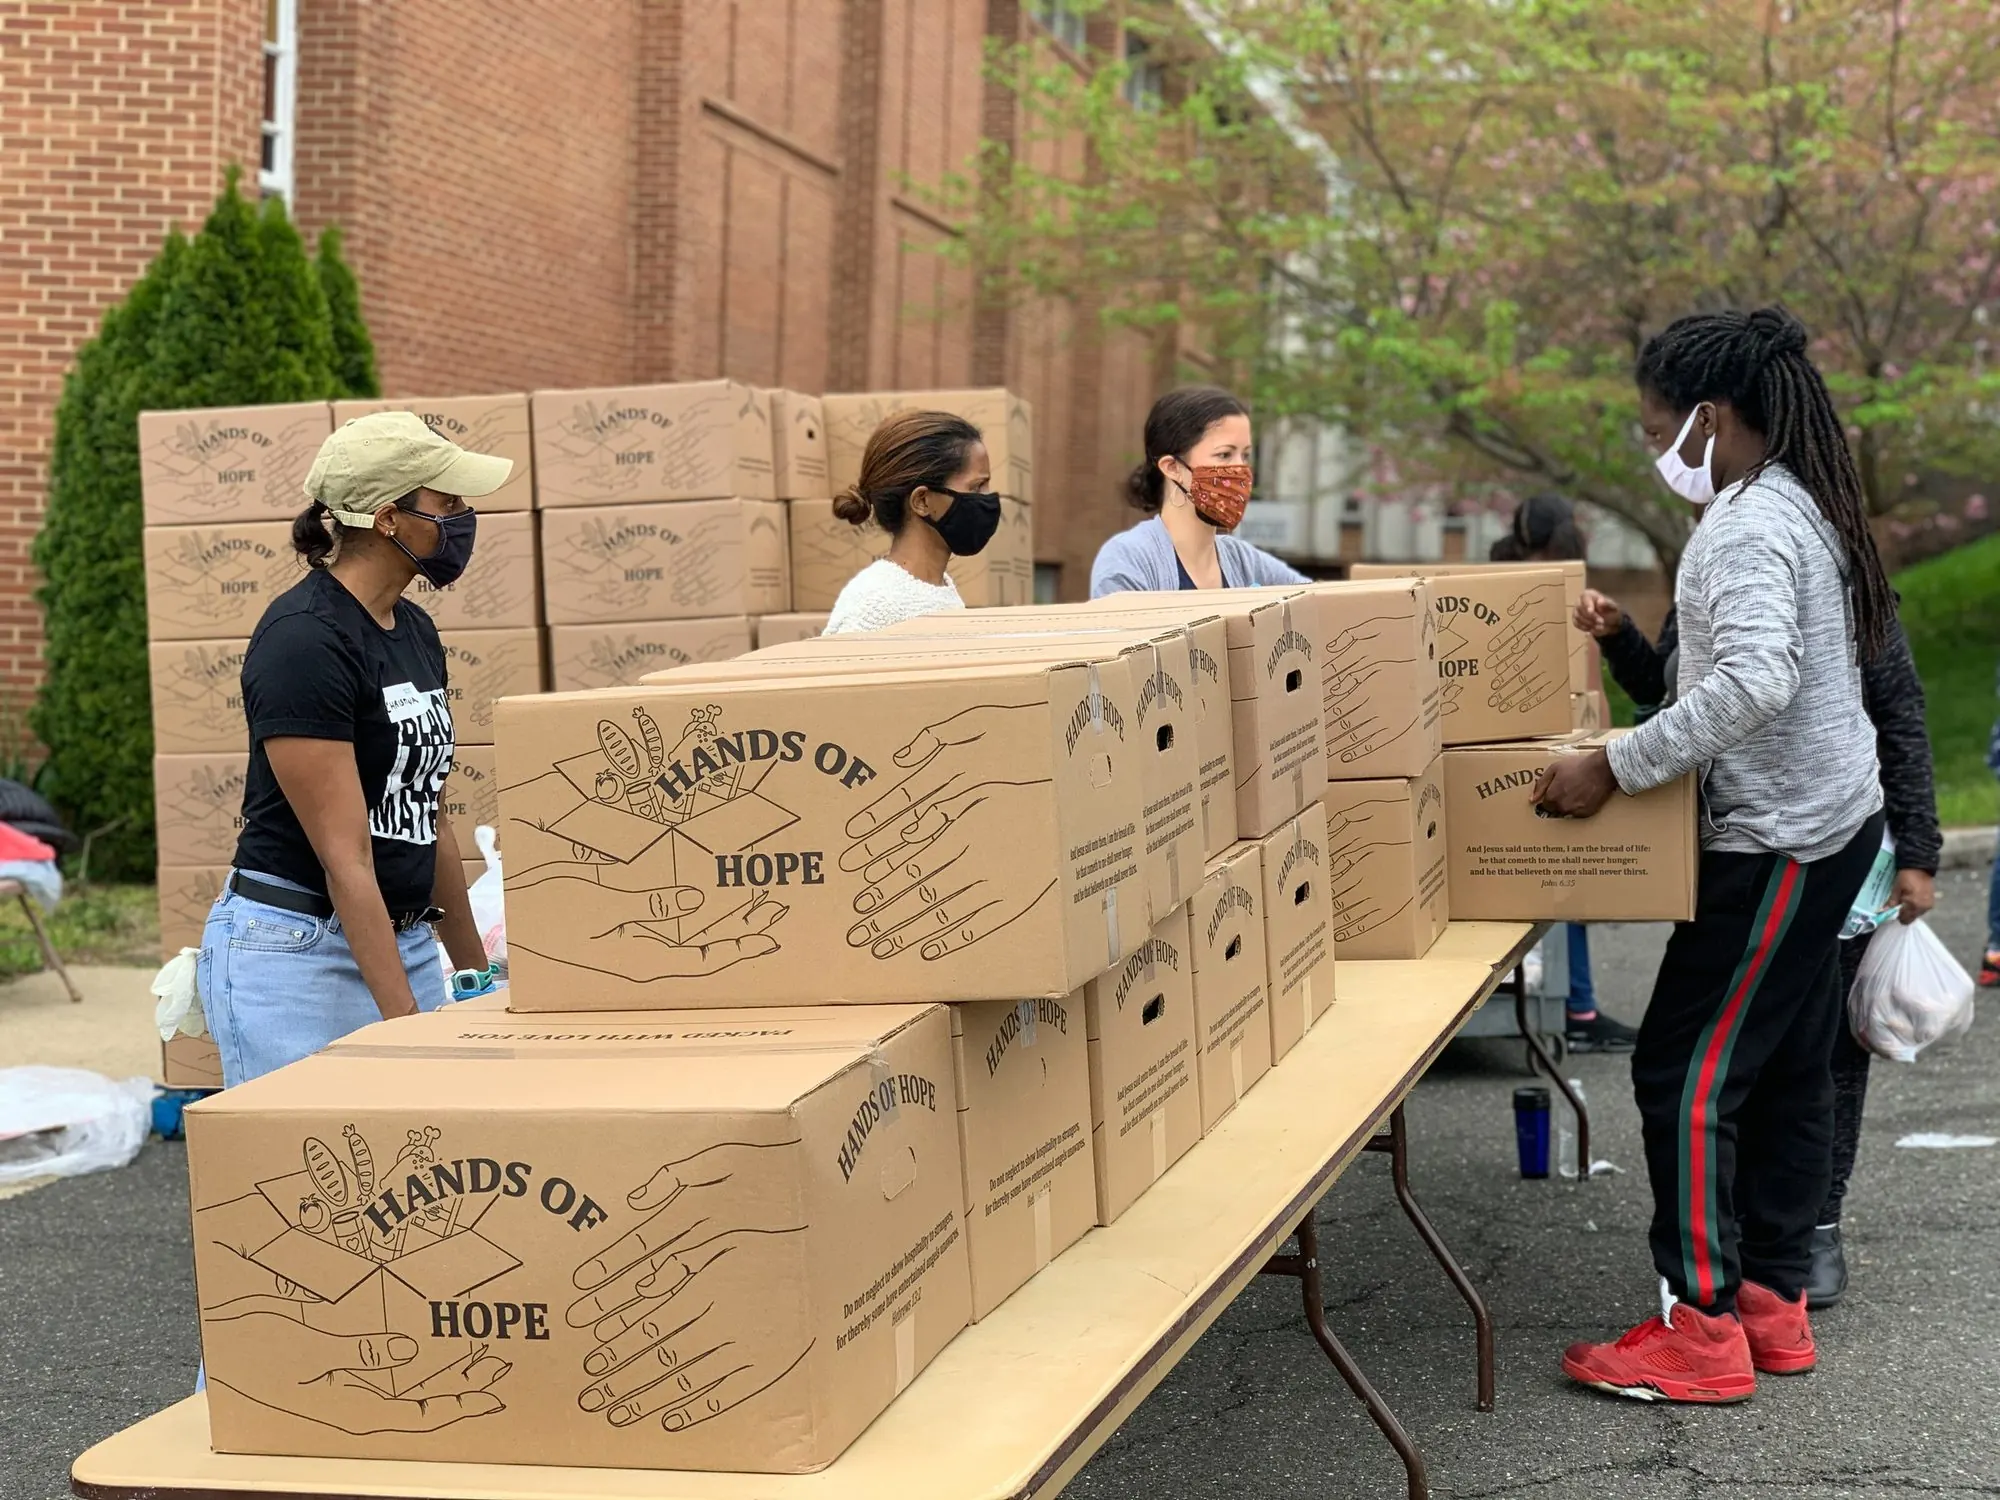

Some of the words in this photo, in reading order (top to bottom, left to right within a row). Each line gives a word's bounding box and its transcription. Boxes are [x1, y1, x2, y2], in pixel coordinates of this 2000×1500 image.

[447, 418, 469, 434] OF
[595, 408, 649, 433] HANDS
[651, 412, 674, 429] OF
[197, 428, 248, 453] HANDS
[251, 432, 273, 448] OF
[615, 451, 654, 465] HOPE
[218, 469, 256, 484] HOPE
[603, 524, 657, 551] HANDS
[660, 528, 683, 546] OF
[201, 539, 252, 564] HANDS
[254, 543, 277, 560] OF
[221, 580, 259, 594] HOPE
[418, 581, 456, 593] HOE
[624, 567, 664, 582] HOPE
[1436, 596, 1470, 614] NDS
[1473, 602, 1500, 626] OF
[206, 654, 246, 678] HAND
[460, 650, 481, 666] OF
[613, 643, 667, 669] HANDS
[670, 648, 692, 664] OF
[1190, 649, 1198, 669] OF
[1199, 649, 1218, 683] HOPE
[1267, 634, 1286, 681] HANDS
[1294, 632, 1312, 663] HOPE
[227, 697, 245, 709] HO
[447, 689, 463, 700] PE
[1136, 674, 1157, 730] HANDS
[1156, 670, 1165, 693] OF
[1164, 672, 1183, 712] HOPE
[1066, 695, 1090, 758] HANDS
[1091, 693, 1101, 719] OF
[1102, 695, 1124, 743] HOPE
[389, 745, 452, 795] LIVE
[463, 766, 485, 781] OF
[654, 730, 807, 803] HANDS
[814, 742, 878, 789] OF
[213, 774, 245, 798] HAN
[1475, 768, 1545, 800] HANDS
[444, 803, 466, 815] PE
[1466, 845, 1482, 853] And
[1483, 845, 1504, 854] Jesus
[1505, 845, 1521, 853] said
[1523, 845, 1542, 853] unto
[1566, 845, 1570, 853] I
[1585, 845, 1599, 853] the
[1600, 845, 1624, 853] bread
[1625, 845, 1634, 853] of
[1479, 856, 1489, 864] he
[1490, 856, 1506, 864] that
[1507, 856, 1537, 864] cometh
[1538, 856, 1547, 864] to
[1561, 856, 1581, 864] shall
[715, 851, 825, 887] HOPE
[1278, 845, 1295, 896] HANDS
[1303, 839, 1320, 866] HOPE
[1470, 867, 1485, 875] and
[1486, 867, 1496, 875] he
[1497, 867, 1513, 875] that
[1514, 867, 1551, 875] believeth
[1578, 867, 1598, 875] shall
[1540, 880, 1558, 888] John
[1208, 892, 1227, 948] HANDS
[1227, 886, 1236, 908] OF
[1236, 886, 1253, 916] HOPE
[1116, 948, 1143, 1012] HANDS
[1143, 939, 1154, 965] OF
[1155, 939, 1178, 972] HOPE
[681, 1030, 793, 1039] PACKED
[986, 1005, 1021, 1080] HANDS
[1038, 998, 1067, 1035] HOPE
[837, 1090, 880, 1184] HANDS
[879, 1076, 897, 1111] OF
[898, 1074, 935, 1112] HOPE
[363, 1158, 532, 1237] HANDS
[540, 1177, 608, 1232] OF
[854, 1293, 865, 1311] not
[865, 1277, 885, 1301] neglect
[890, 1260, 904, 1279] show
[836, 1335, 847, 1351] for
[847, 1314, 871, 1341] thereby
[872, 1301, 885, 1322] some
[885, 1289, 898, 1308] have
[926, 1247, 940, 1269] angels
[429, 1301, 550, 1339] HOPE
